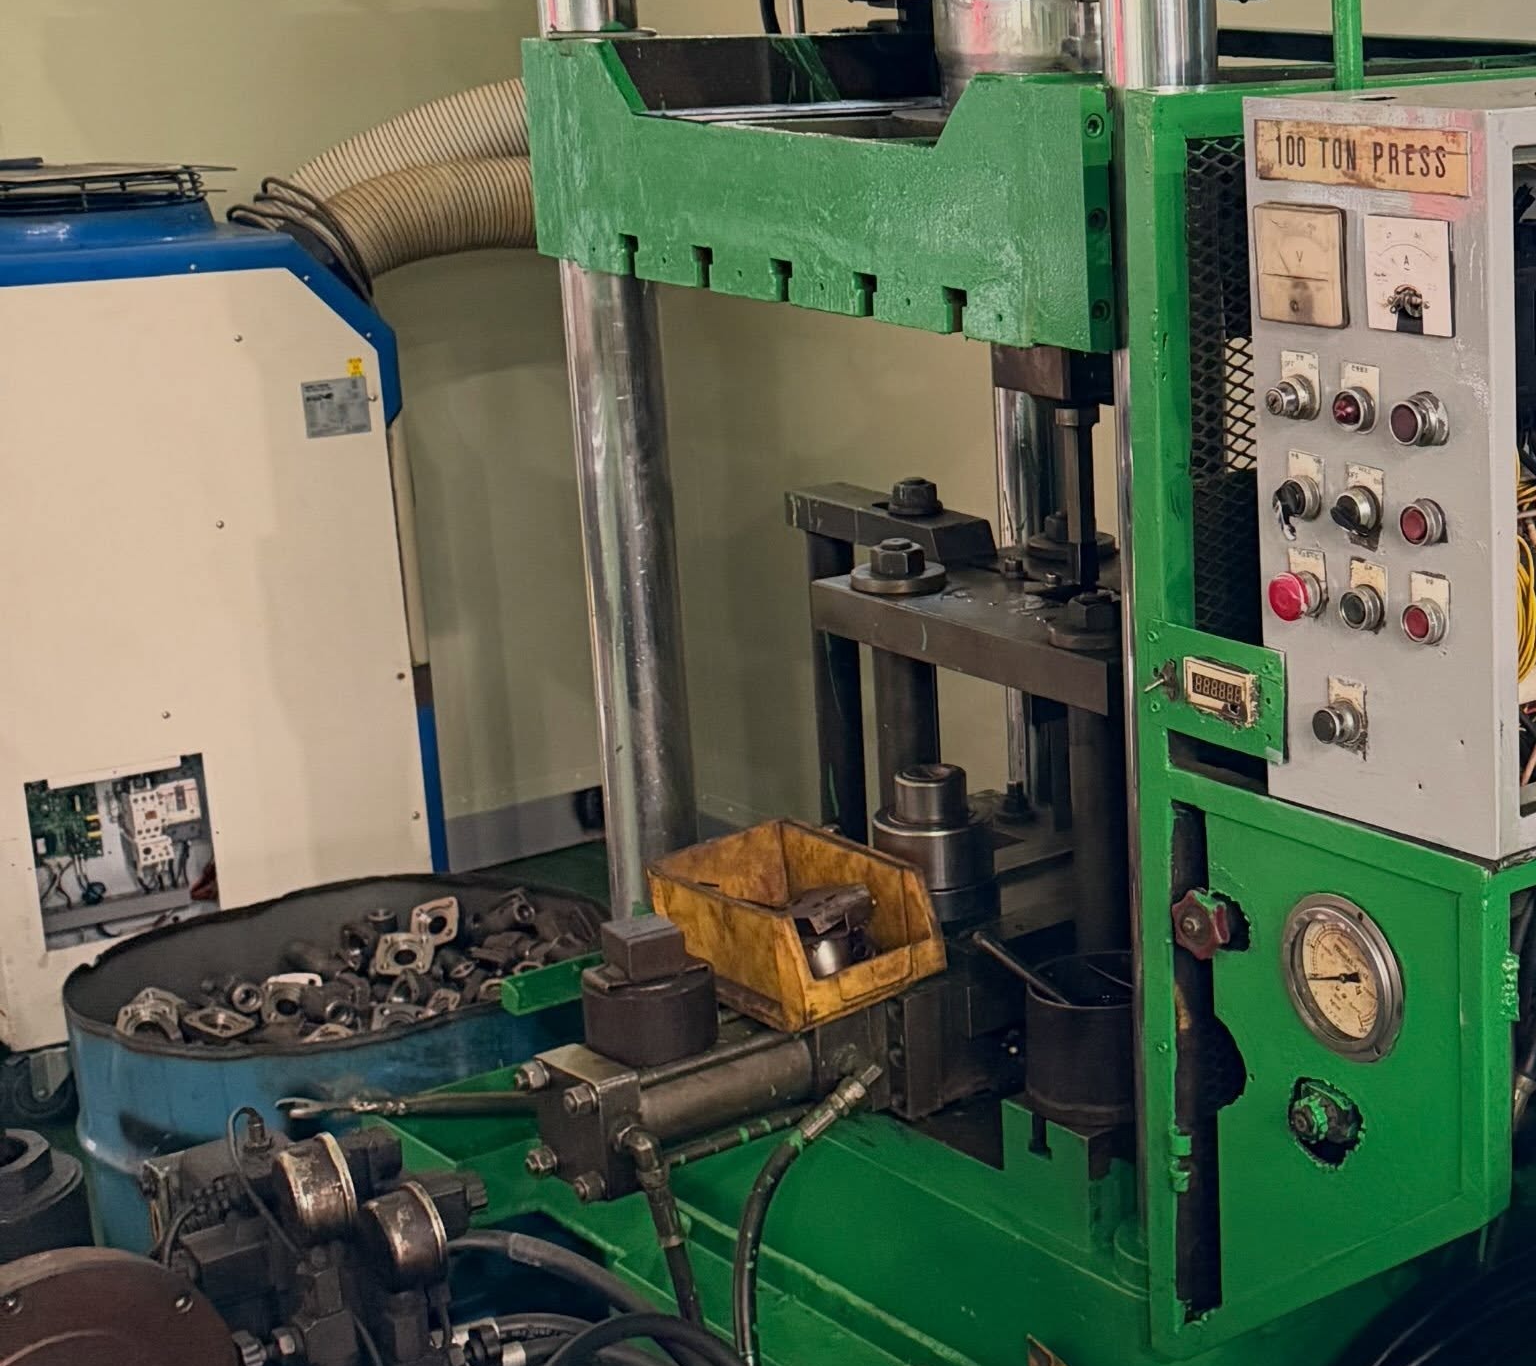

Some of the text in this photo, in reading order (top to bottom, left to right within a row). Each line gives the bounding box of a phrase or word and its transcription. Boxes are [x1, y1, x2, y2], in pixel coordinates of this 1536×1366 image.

[1276, 135, 1447, 178] 100 TON PRESS
